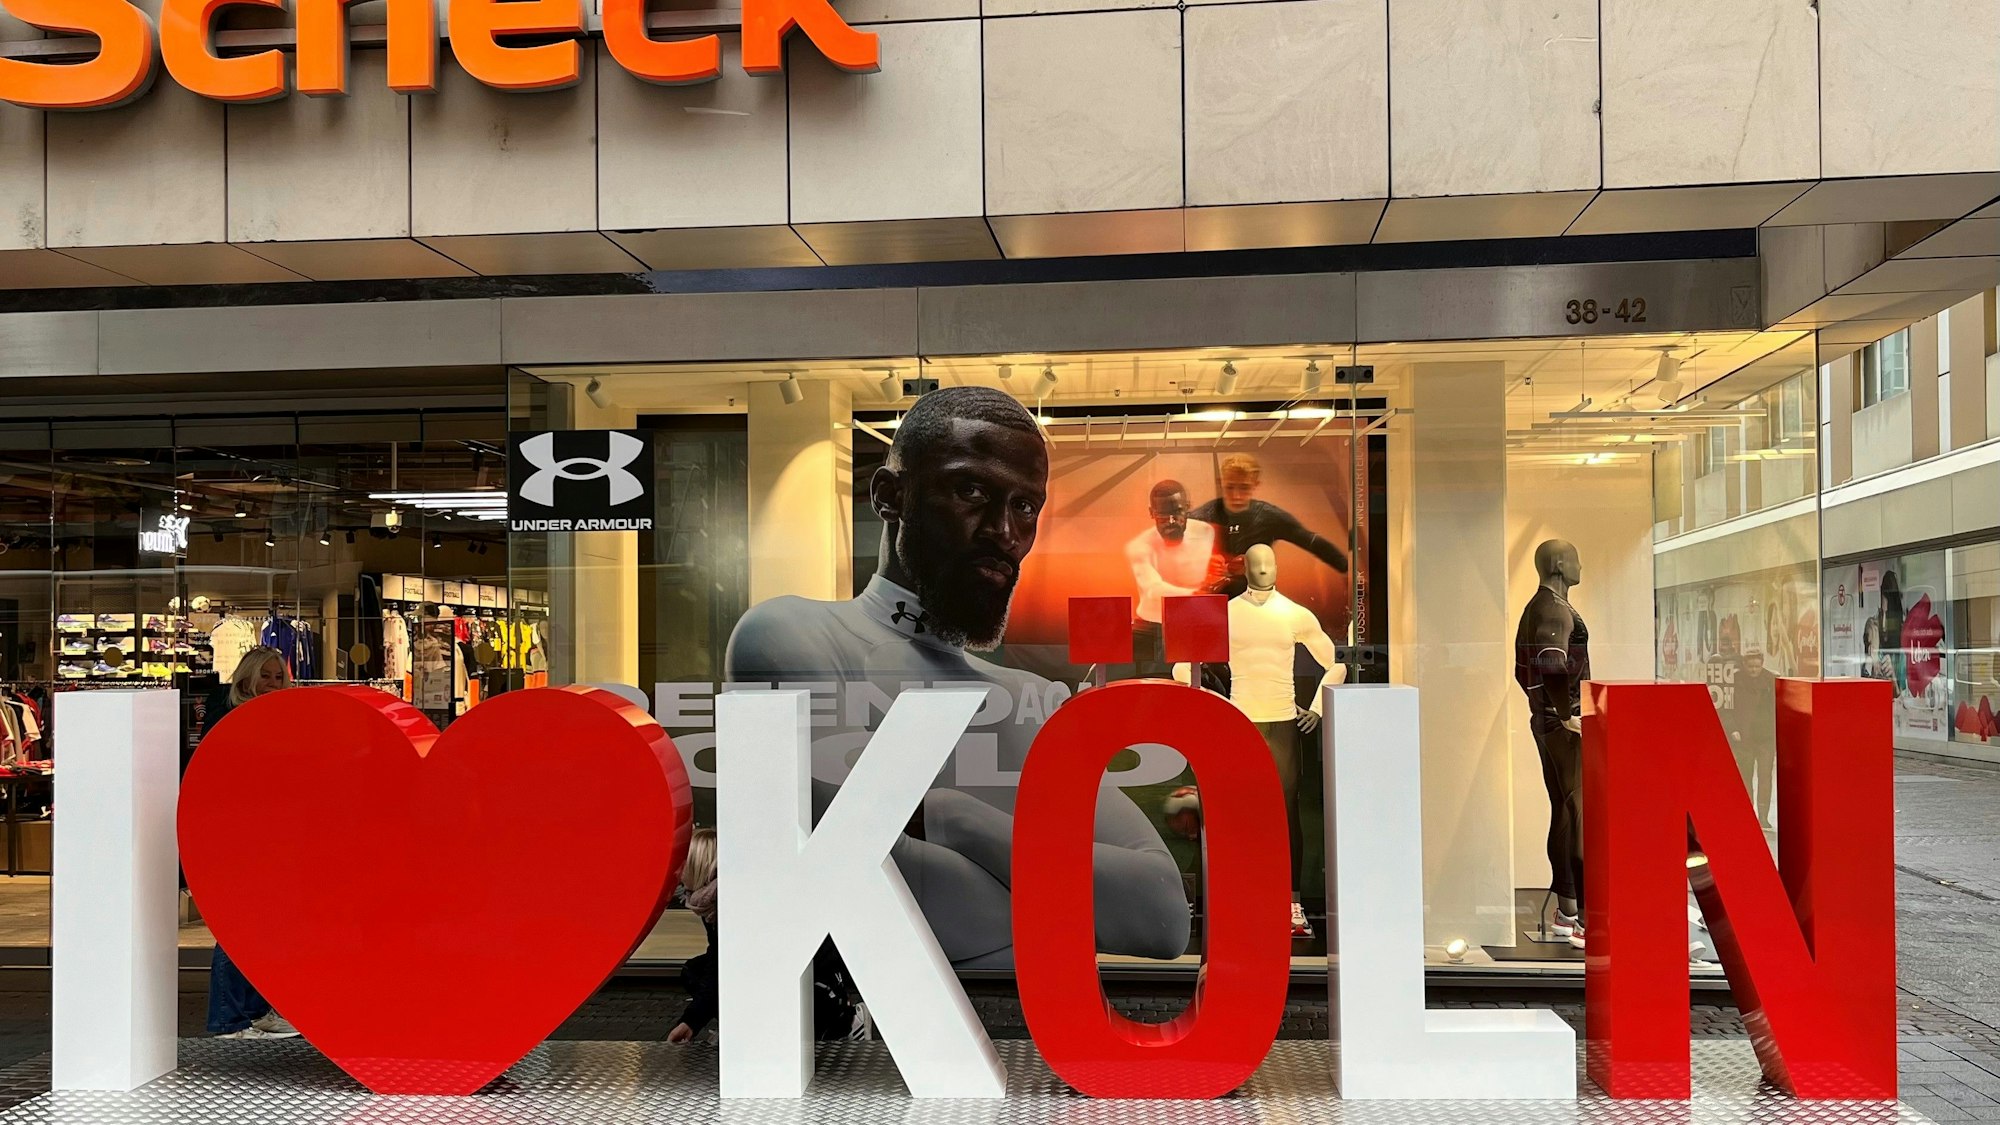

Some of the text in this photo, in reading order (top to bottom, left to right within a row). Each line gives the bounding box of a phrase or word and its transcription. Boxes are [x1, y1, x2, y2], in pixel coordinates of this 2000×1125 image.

[511, 518, 653, 531] UNDER ARMOUR
[52, 596, 1897, 1100] I KÖLN
